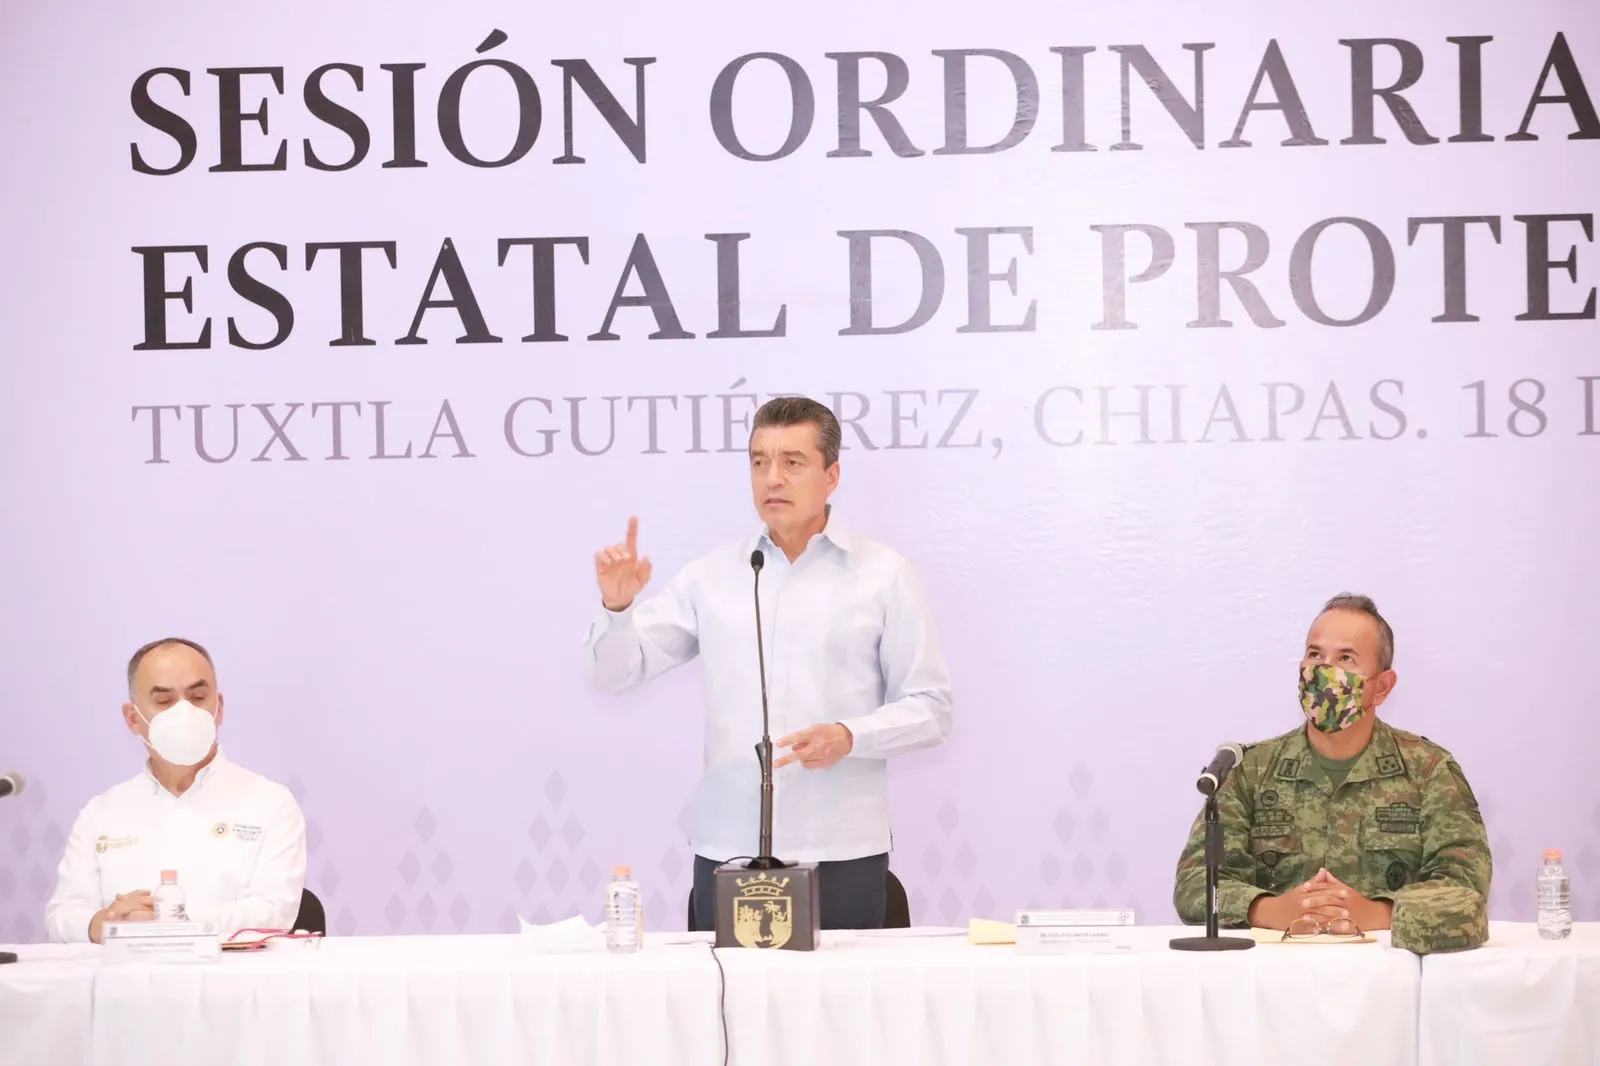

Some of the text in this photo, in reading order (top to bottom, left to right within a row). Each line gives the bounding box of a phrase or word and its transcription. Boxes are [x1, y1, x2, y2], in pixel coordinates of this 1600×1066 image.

[130, 28, 1600, 176] SESIÓN ORDINARIA
[131, 212, 1598, 351] ESTATAL DE PROTE
[132, 398, 476, 464] TUXTLA
[504, 377, 1003, 460] GUTIÉREZ,
[1033, 378, 1427, 447] CHIAPAS.
[1461, 378, 1548, 438] 18
